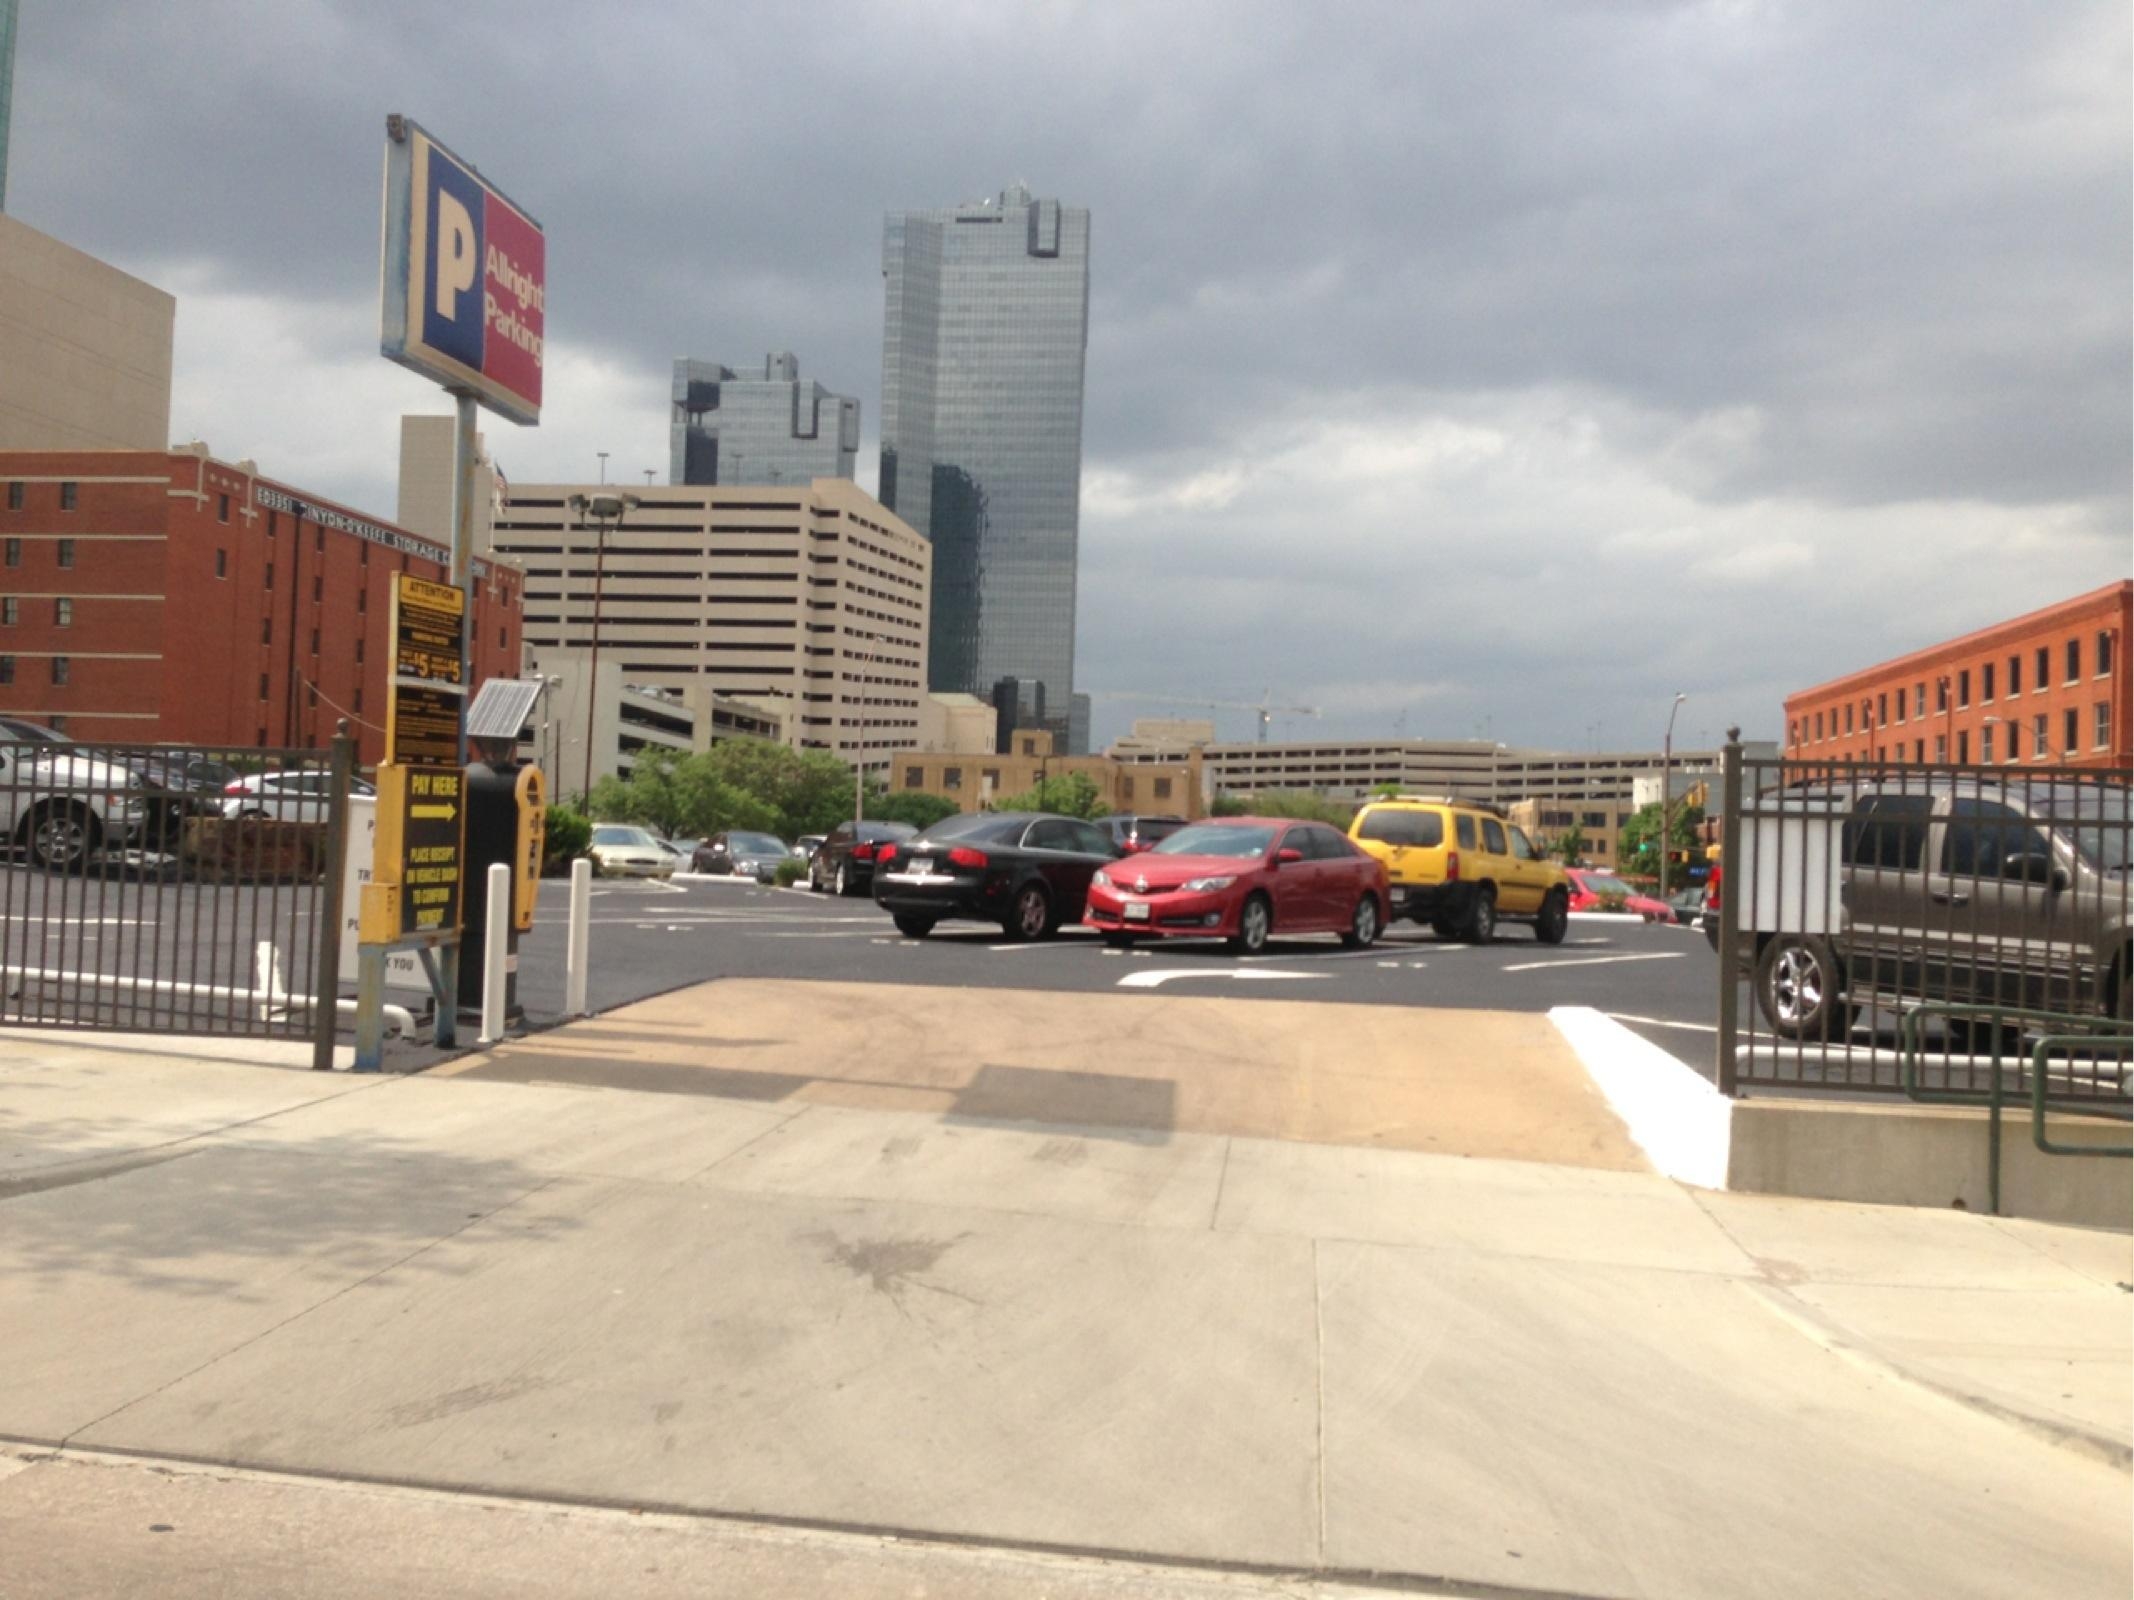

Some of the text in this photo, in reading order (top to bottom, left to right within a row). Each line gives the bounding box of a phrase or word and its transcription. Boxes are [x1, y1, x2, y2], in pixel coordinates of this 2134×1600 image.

[436, 187, 477, 322] P
[485, 244, 544, 313] Allright
[484, 292, 544, 367] Parking
[409, 581, 455, 601] ATTENTION
[411, 774, 458, 796] PAY HERE
[410, 847, 429, 863] PLACE
[393, 956, 414, 971] YOU
